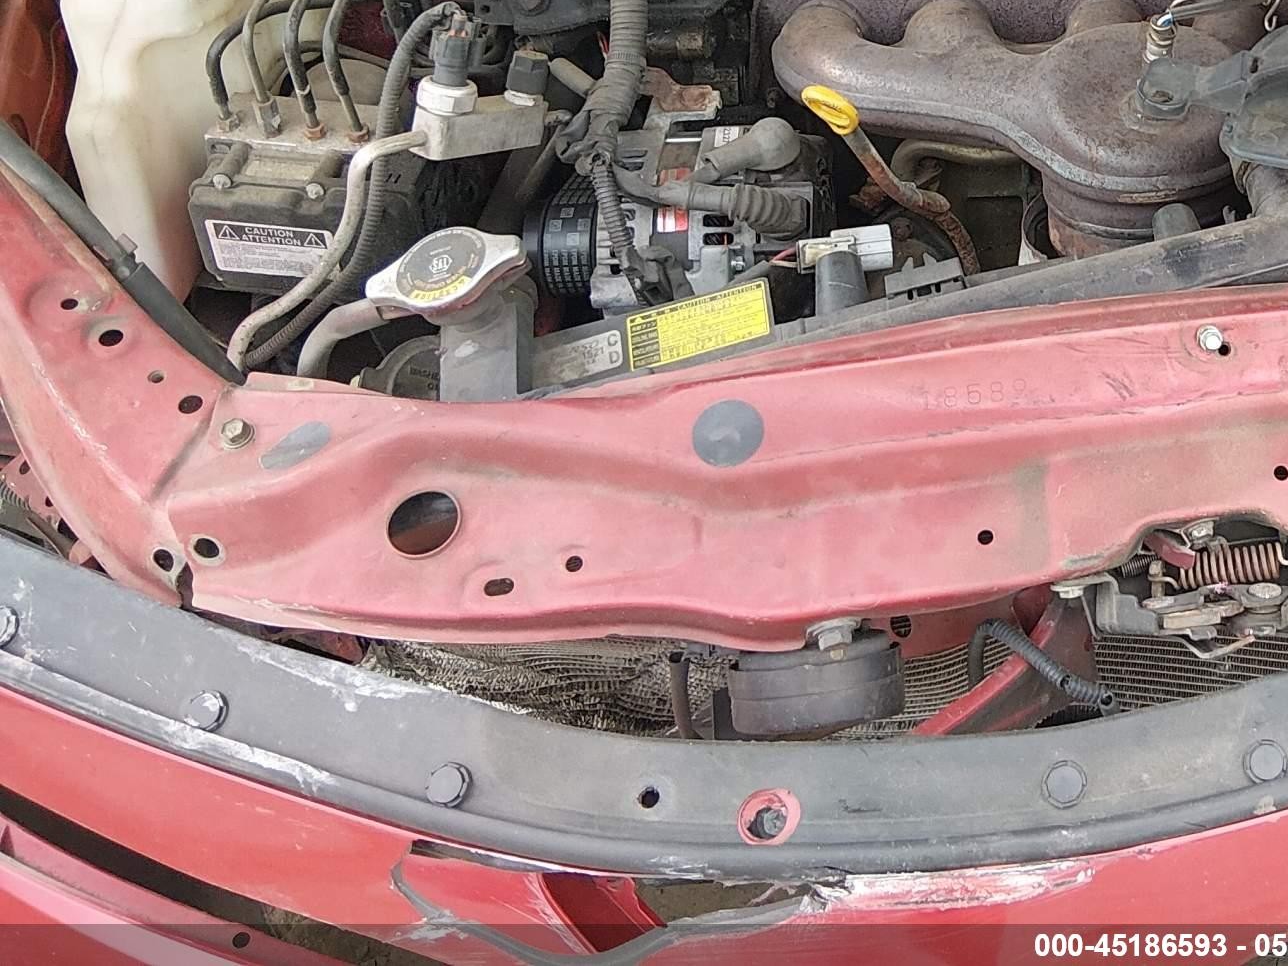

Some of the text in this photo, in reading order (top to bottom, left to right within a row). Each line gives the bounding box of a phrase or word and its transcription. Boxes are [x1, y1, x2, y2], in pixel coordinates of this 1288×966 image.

[244, 226, 295, 239] CAUTION
[241, 234, 302, 246] ATTENTION
[608, 350, 621, 365] D
